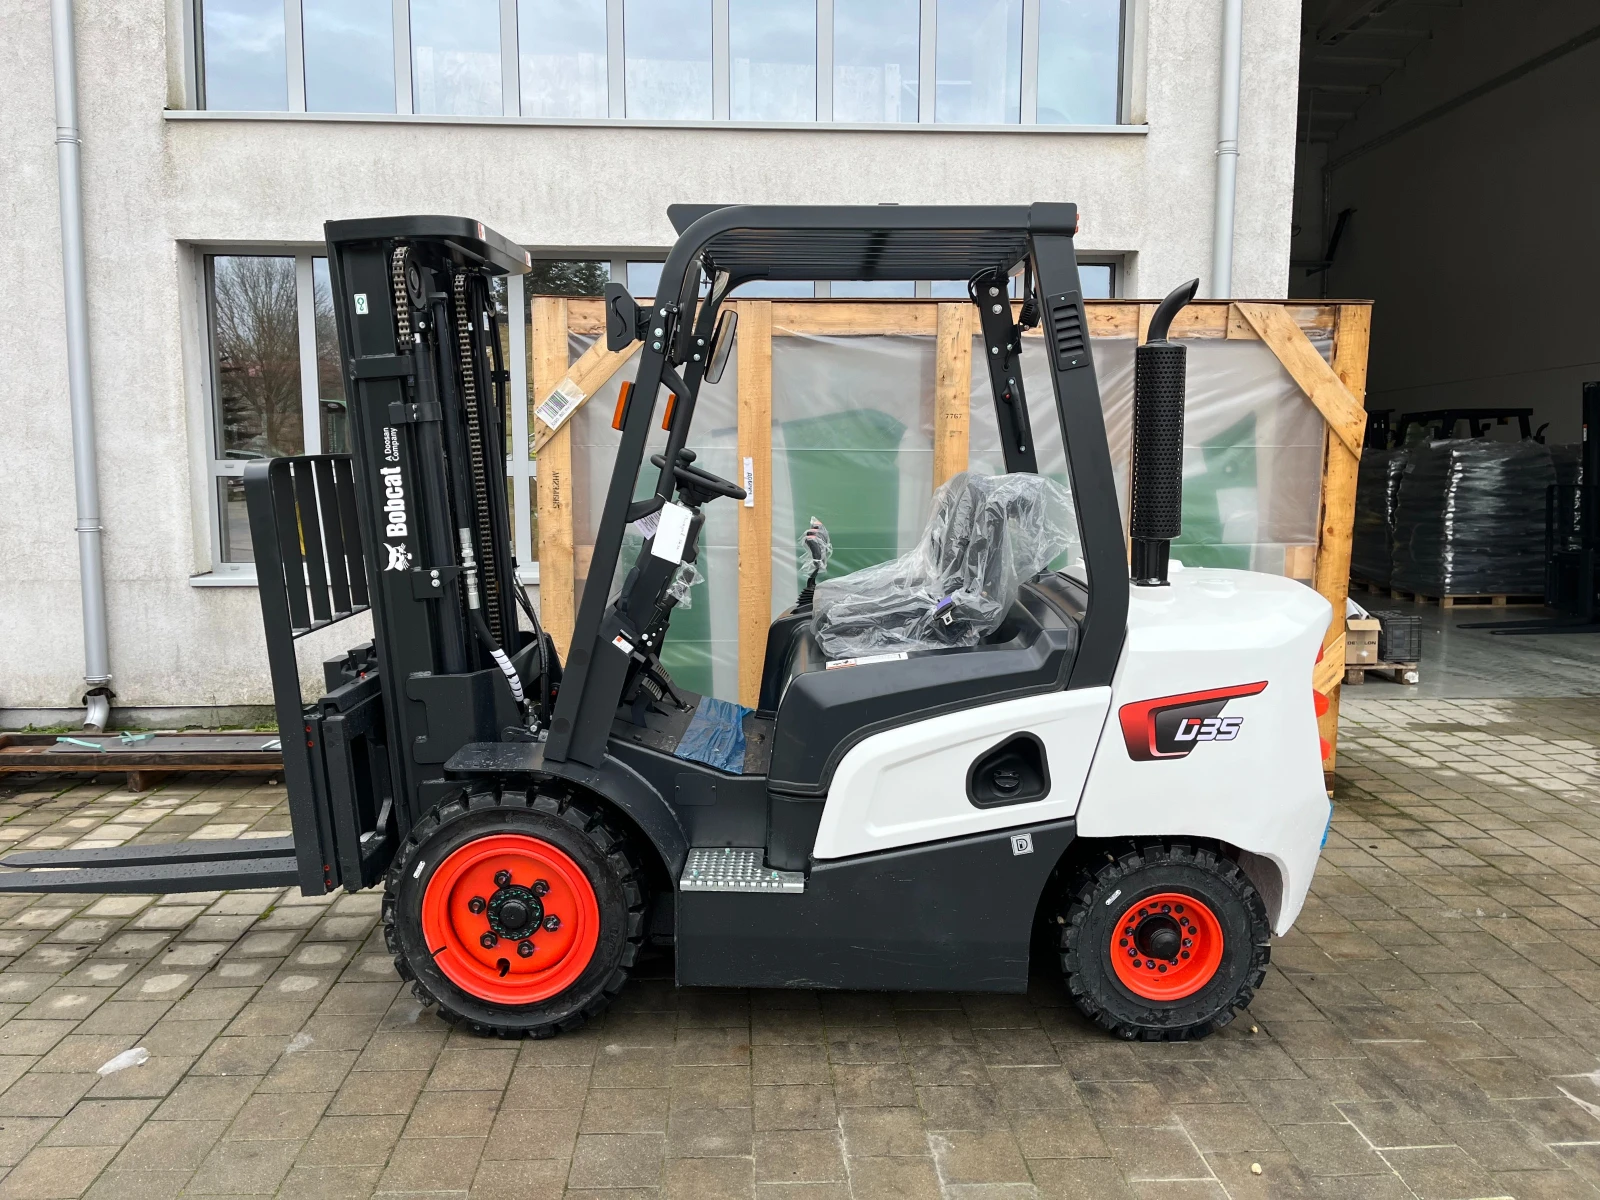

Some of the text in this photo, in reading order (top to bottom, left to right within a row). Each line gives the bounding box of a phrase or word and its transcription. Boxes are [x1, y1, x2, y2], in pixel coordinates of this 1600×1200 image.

[383, 427, 393, 462] A Doosan
[390, 427, 400, 462] Company
[380, 466, 408, 537] Bobcat
[1174, 716, 1244, 741] D35
